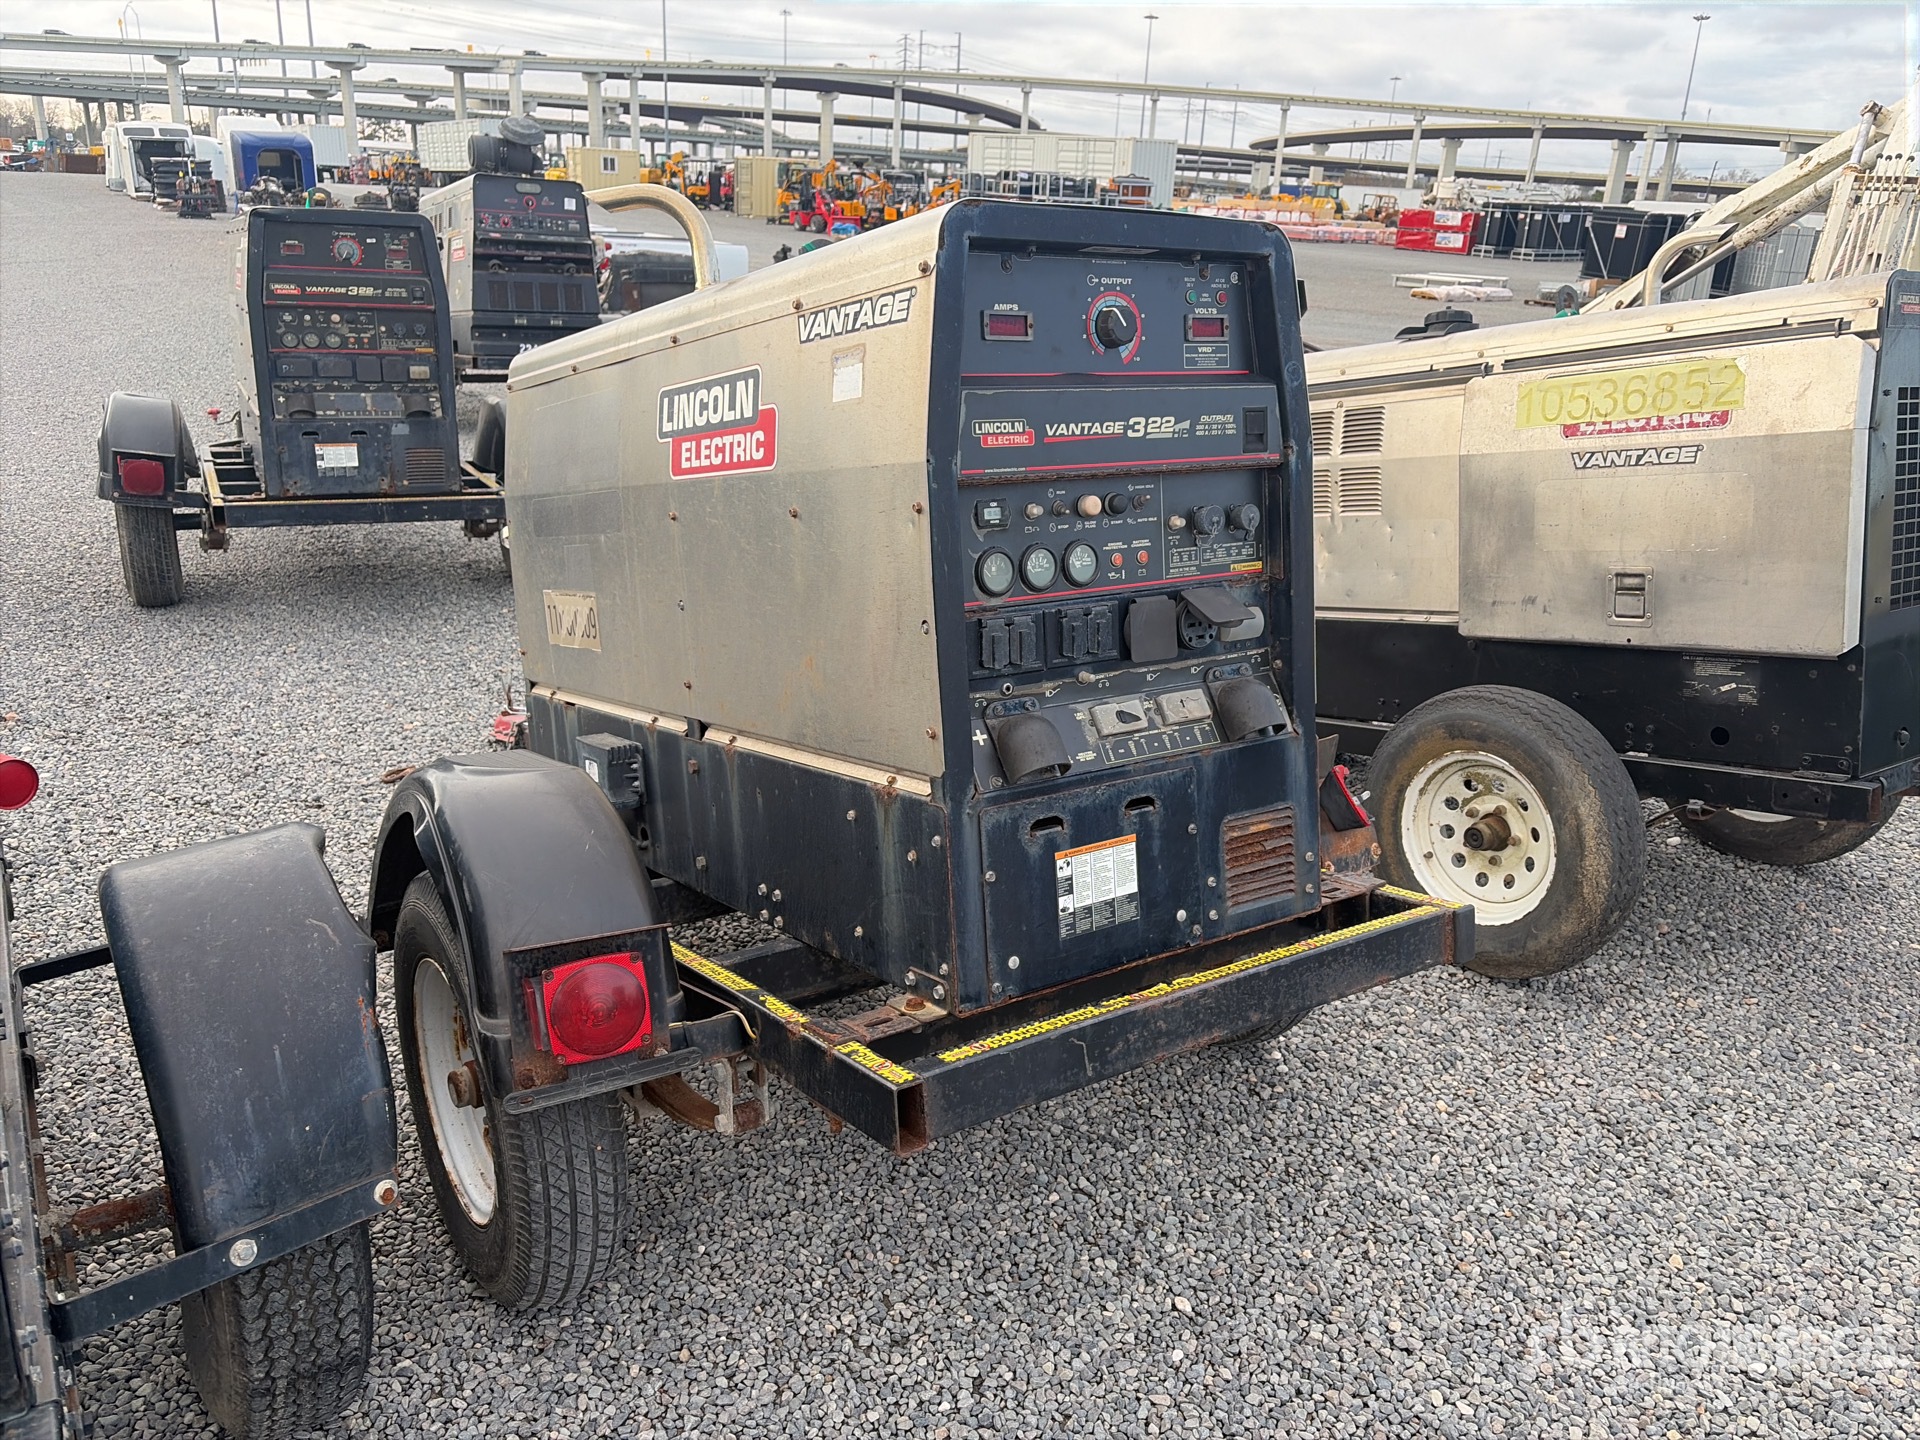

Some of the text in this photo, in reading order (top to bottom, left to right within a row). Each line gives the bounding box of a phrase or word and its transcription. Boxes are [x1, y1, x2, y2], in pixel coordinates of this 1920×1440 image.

[348, 286, 374, 295] 322
[799, 290, 912, 342] VANTAGE
[662, 378, 754, 432] LINCOLN
[1518, 364, 1744, 424] 10536852
[975, 422, 1023, 434] LINCOLN
[987, 436, 1029, 444] ELECTRIC
[1045, 421, 1124, 436] VANTAGE
[1127, 416, 1175, 438] 322
[681, 430, 764, 468] ELECTRIC
[1572, 446, 1698, 468] VANTAGE
[990, 1009, 1094, 1045] DO NOT STAND
